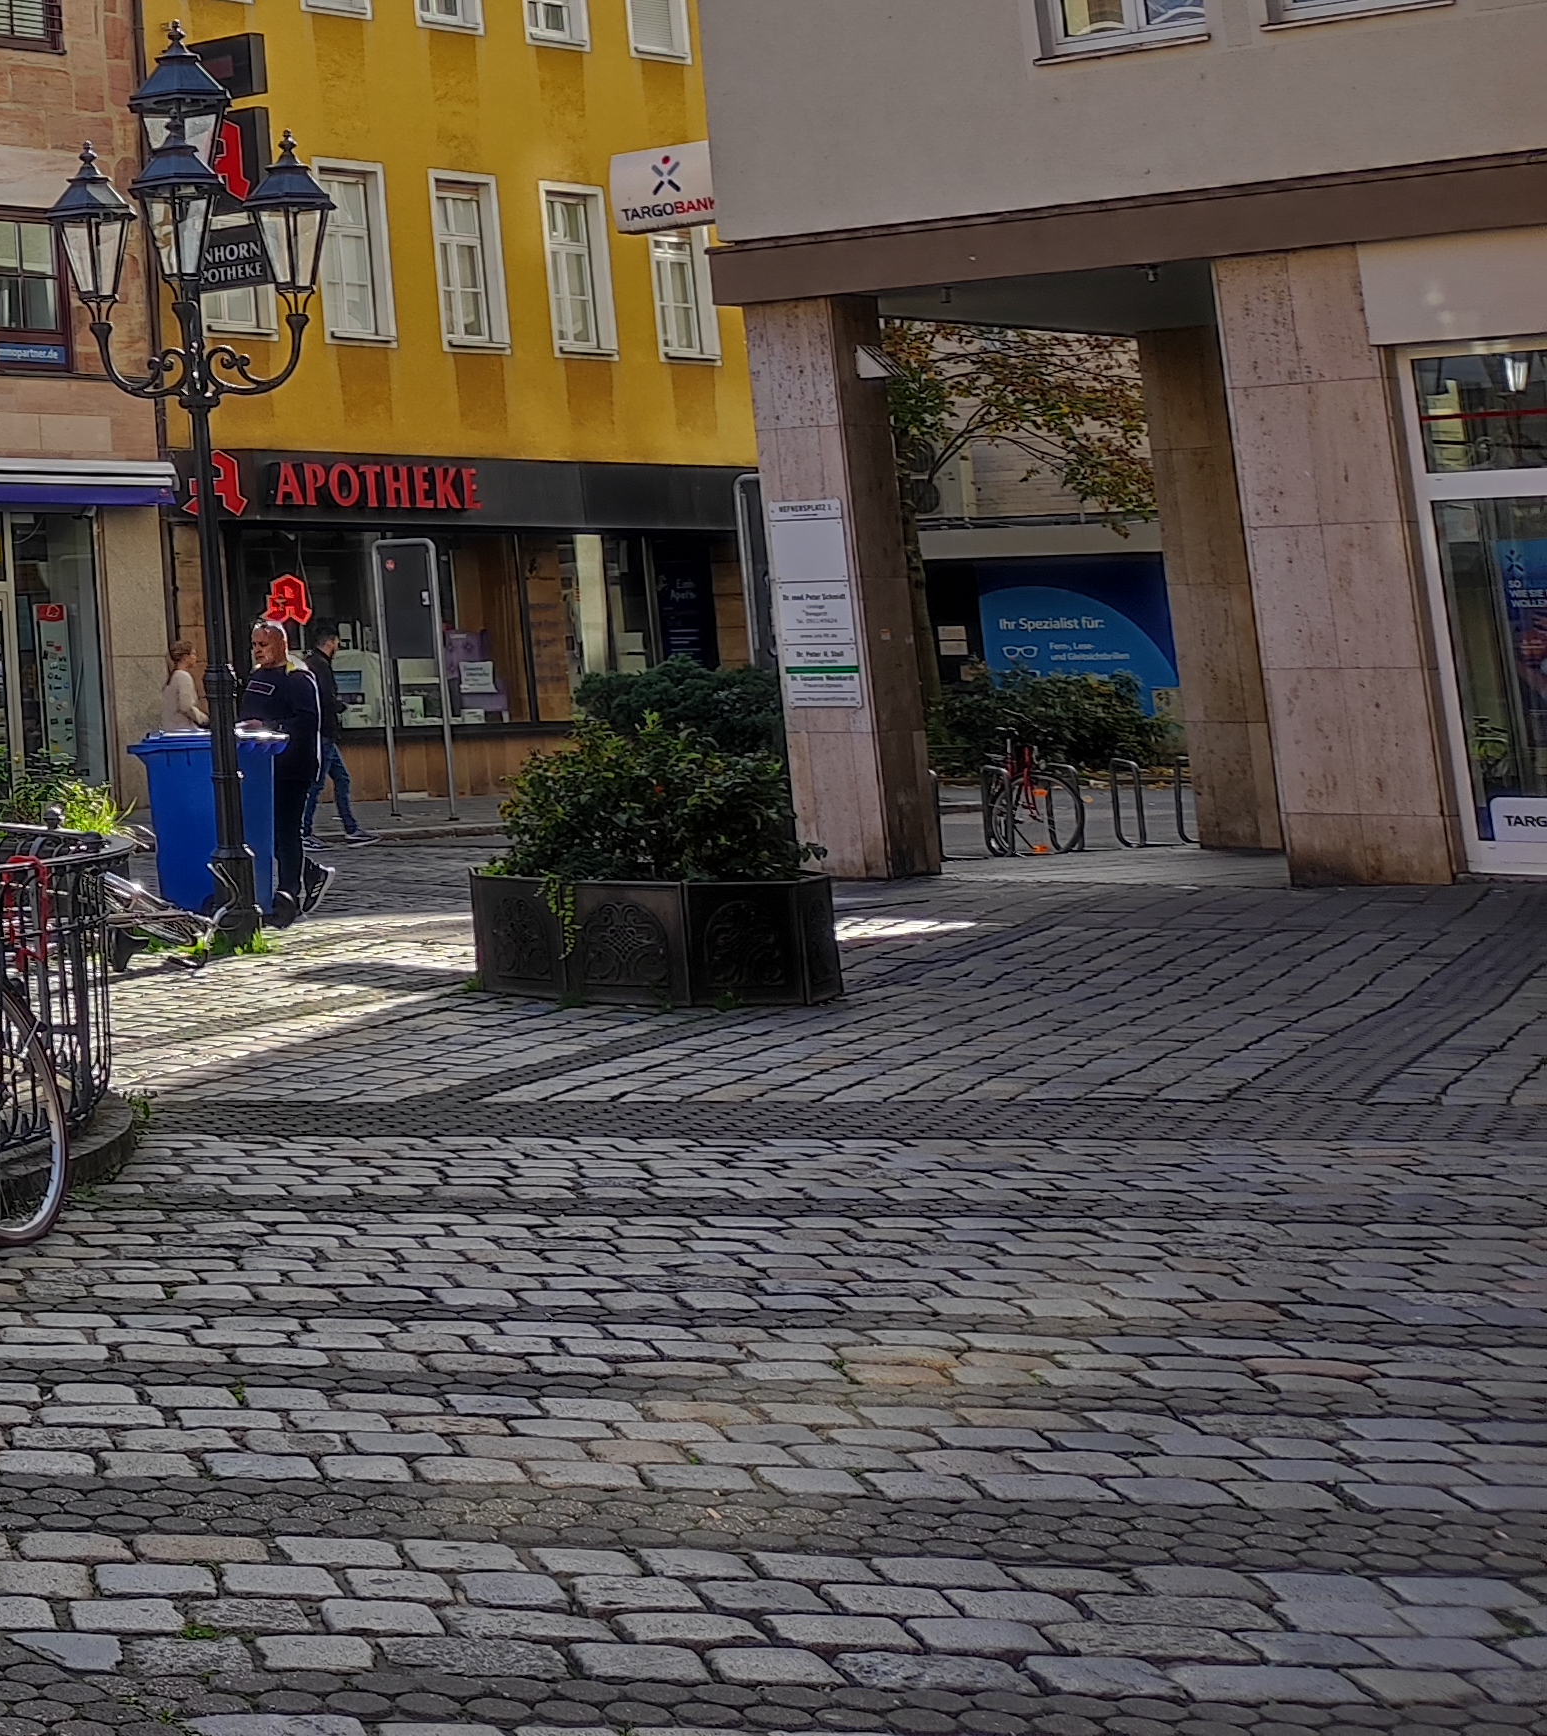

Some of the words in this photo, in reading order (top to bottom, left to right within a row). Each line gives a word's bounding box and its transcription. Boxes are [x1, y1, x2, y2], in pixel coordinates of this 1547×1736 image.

[204, 240, 261, 264] NHORN
[200, 261, 263, 284] POTHEKE
[275, 460, 484, 510] APOTHEKE
[999, 618, 1016, 631] Ihr
[1018, 617, 1080, 633] Spezialist
[1081, 616, 1105, 629] für:
[1050, 652, 1067, 661] und
